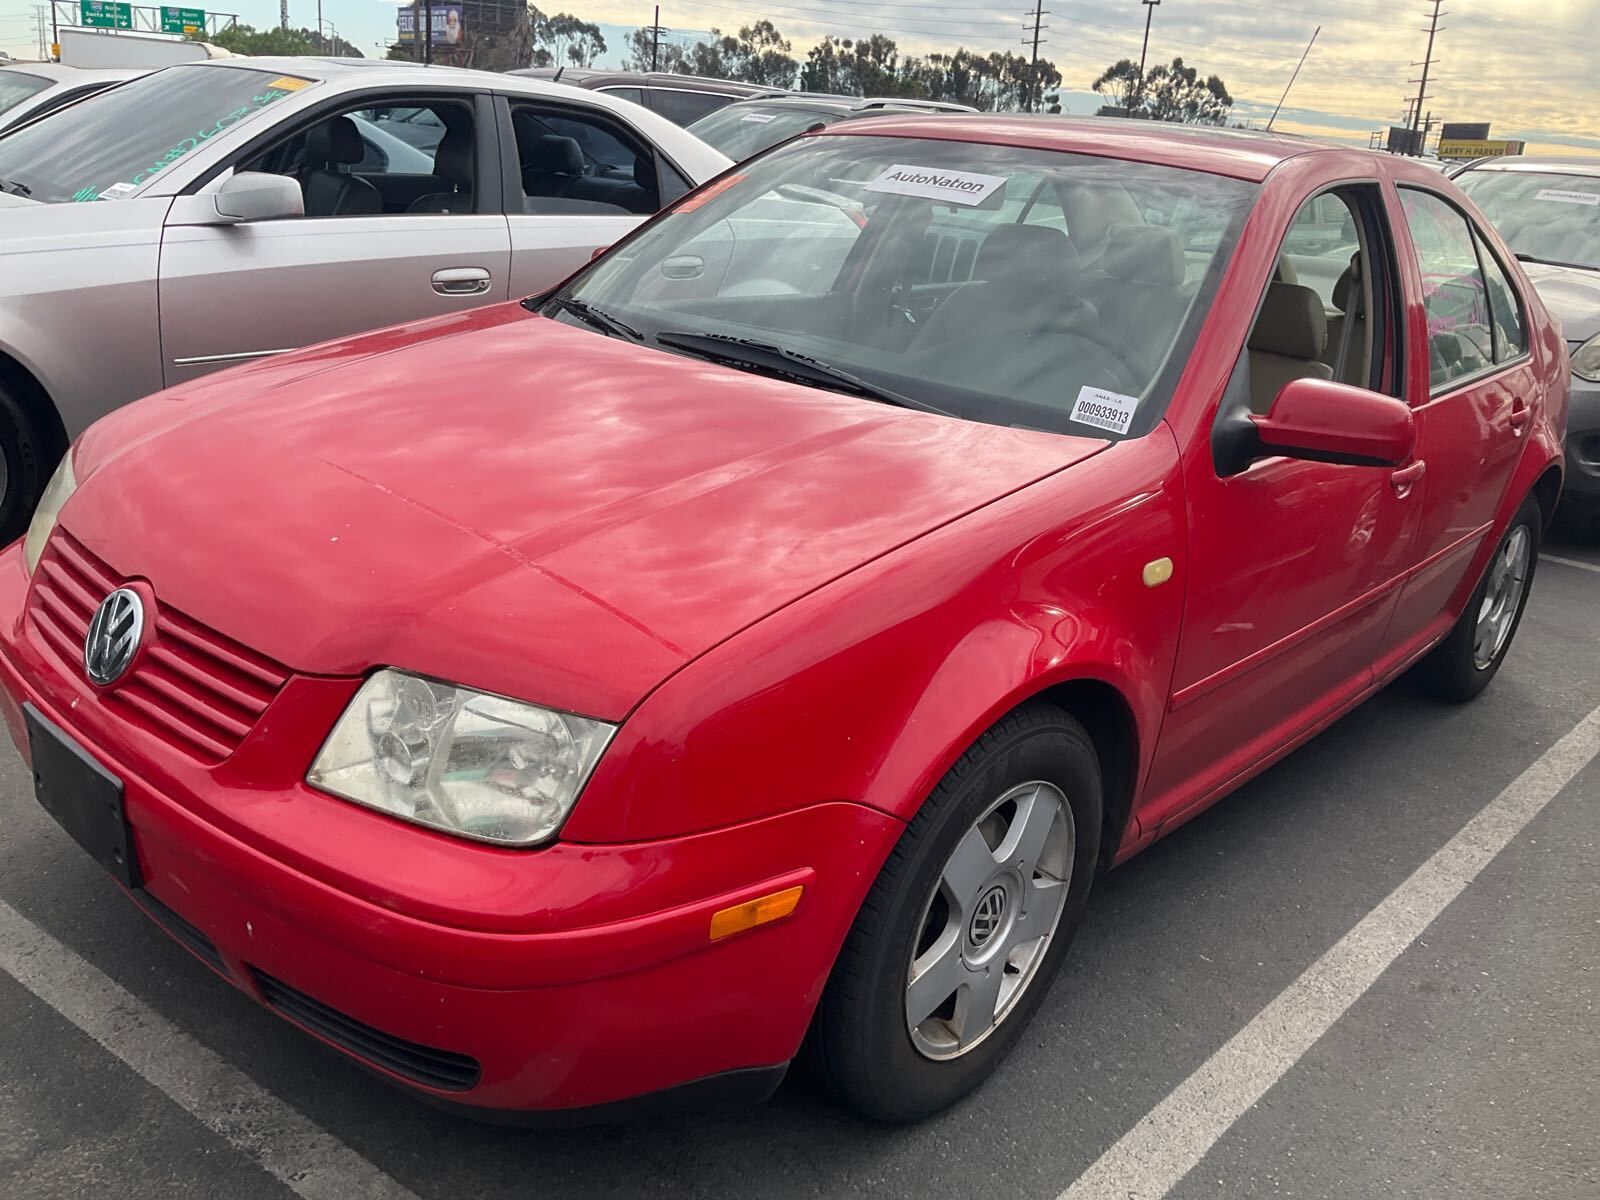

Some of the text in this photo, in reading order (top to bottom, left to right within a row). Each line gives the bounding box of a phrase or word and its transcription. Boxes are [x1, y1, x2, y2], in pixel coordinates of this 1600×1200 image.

[165, 17, 181, 25] Long
[1440, 146, 1465, 155] LARRY
[1473, 147, 1505, 156] PARKER
[886, 171, 985, 193] AutoNation
[1077, 400, 1129, 424] 000933913
